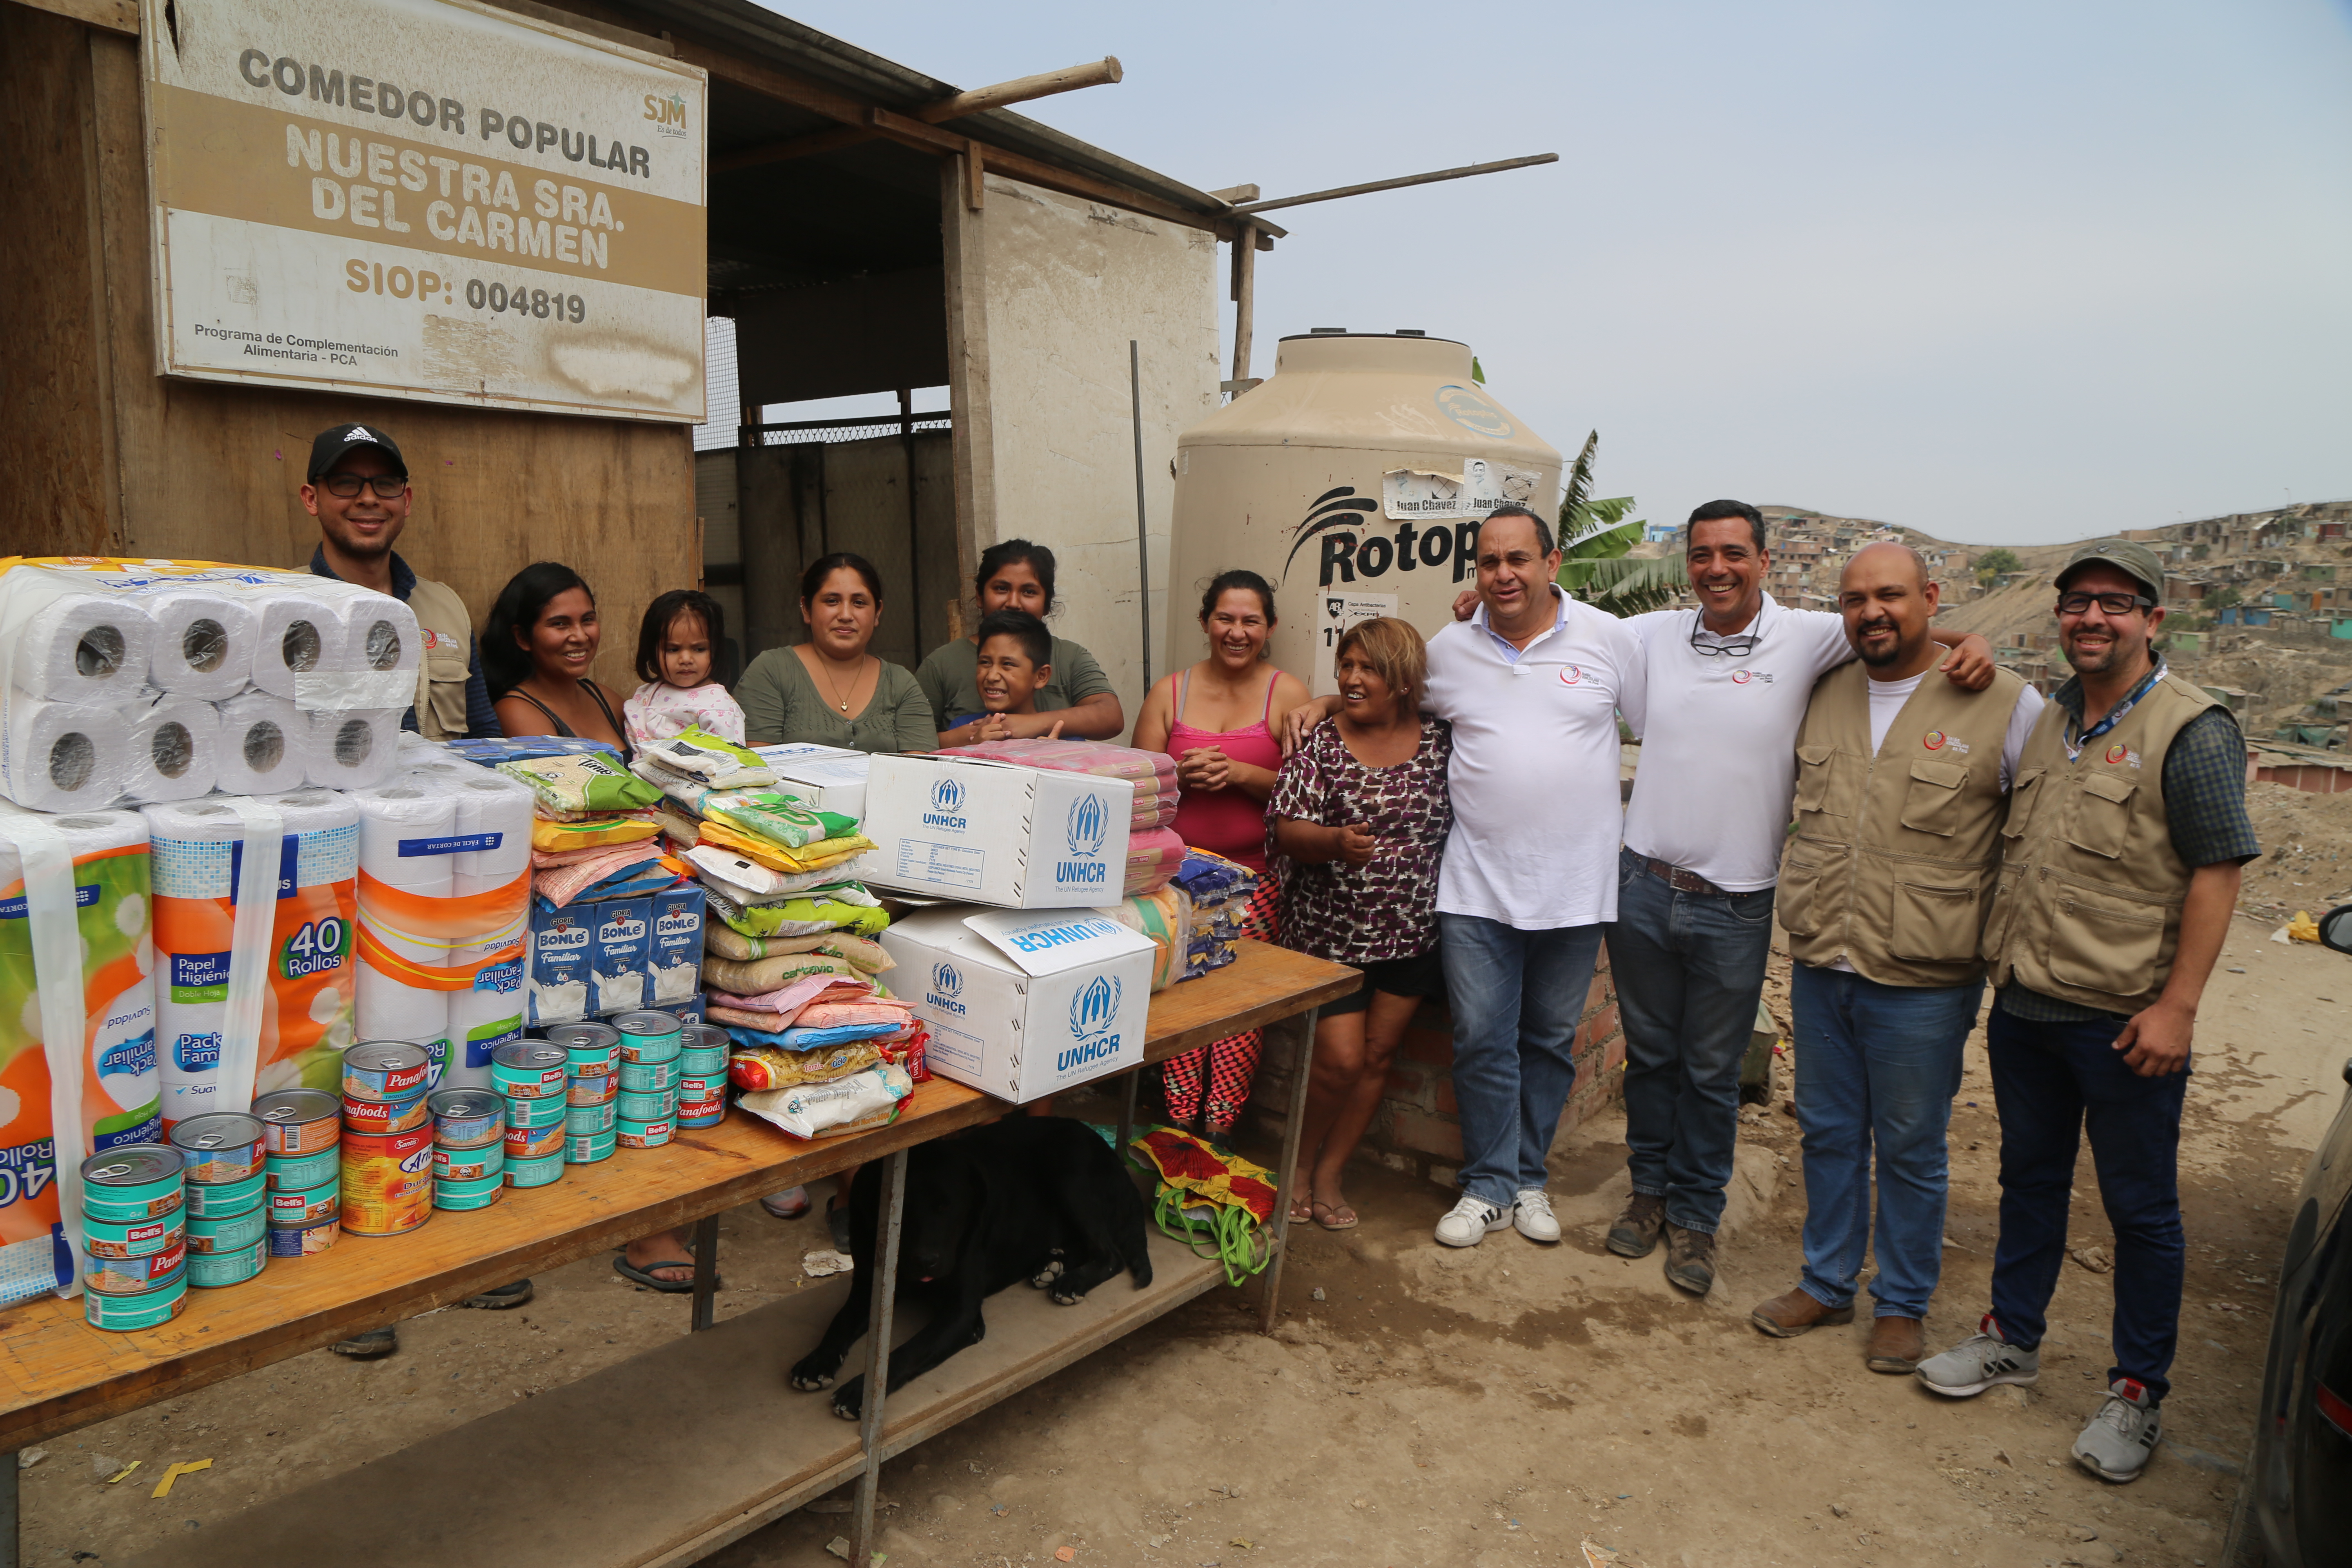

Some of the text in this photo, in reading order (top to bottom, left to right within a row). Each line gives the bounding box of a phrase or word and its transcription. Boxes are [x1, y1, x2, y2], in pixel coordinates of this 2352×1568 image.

[239, 48, 650, 179] COMEDOR POPULAR
[644, 94, 686, 129] SJM
[286, 123, 624, 232] NUESTRA SRA.
[312, 177, 608, 270] DEL CARMEN
[345, 258, 586, 324] SIOP: 004819
[195, 324, 399, 357] Programa de Complementación
[244, 344, 358, 366] Alimentaria PCA
[344, 434, 378, 443] adidas
[1396, 500, 1456, 511] Juan Chavez
[1474, 498, 1526, 508] Juan Chavez
[1319, 521, 1479, 587] Rotop
[1324, 628, 1344, 647] 11
[923, 813, 967, 829] UNHCR
[461, 839, 479, 848] FÁCIL
[1056, 862, 1105, 883] UNHCR
[0, 903, 28, 913] CORTA
[611, 909, 632, 919] GLORIA
[667, 903, 686, 912] GLORIA
[550, 917, 574, 927] GLORIA
[291, 920, 341, 957] 40
[1001, 927, 1027, 936] Agency
[1008, 924, 1098, 953] UNHCR
[483, 937, 521, 953] Suavidad
[659, 936, 691, 948] Familiar
[541, 952, 581, 964] Familiar
[604, 944, 637, 957] Familiar
[179, 958, 215, 973] Papel
[289, 954, 341, 976] Rollos
[782, 961, 834, 980] cartavio
[179, 970, 230, 985] Higiénic
[479, 964, 522, 984] Familiar
[497, 976, 521, 994] Pack
[204, 989, 220, 998] Hoja
[927, 992, 966, 1016] UNHCR
[107, 1004, 151, 1029] Suavidad
[939, 1007, 951, 1016] Refugee
[952, 1011, 966, 1021] Agency
[180, 1033, 222, 1049] Pack
[180, 1049, 219, 1062] Fami
[1058, 1033, 1120, 1071] UNHCR
[1078, 1063, 1098, 1076] Refugee
[1099, 1057, 1119, 1070] Agency
[388, 1065, 428, 1087] Panafoo
[543, 1071, 562, 1081] Bell's
[343, 1103, 388, 1118] anafoods
[861, 1116, 875, 1125] Norte
[398, 1139, 417, 1149] Santis
[0, 1142, 53, 1167] Rollo
[433, 1154, 447, 1163] ell's
[406, 1184, 425, 1195] MITADES
[130, 1228, 161, 1239] Bell's
[153, 1240, 186, 1271] Panaf
[151, 1275, 170, 1286] TROZOS
